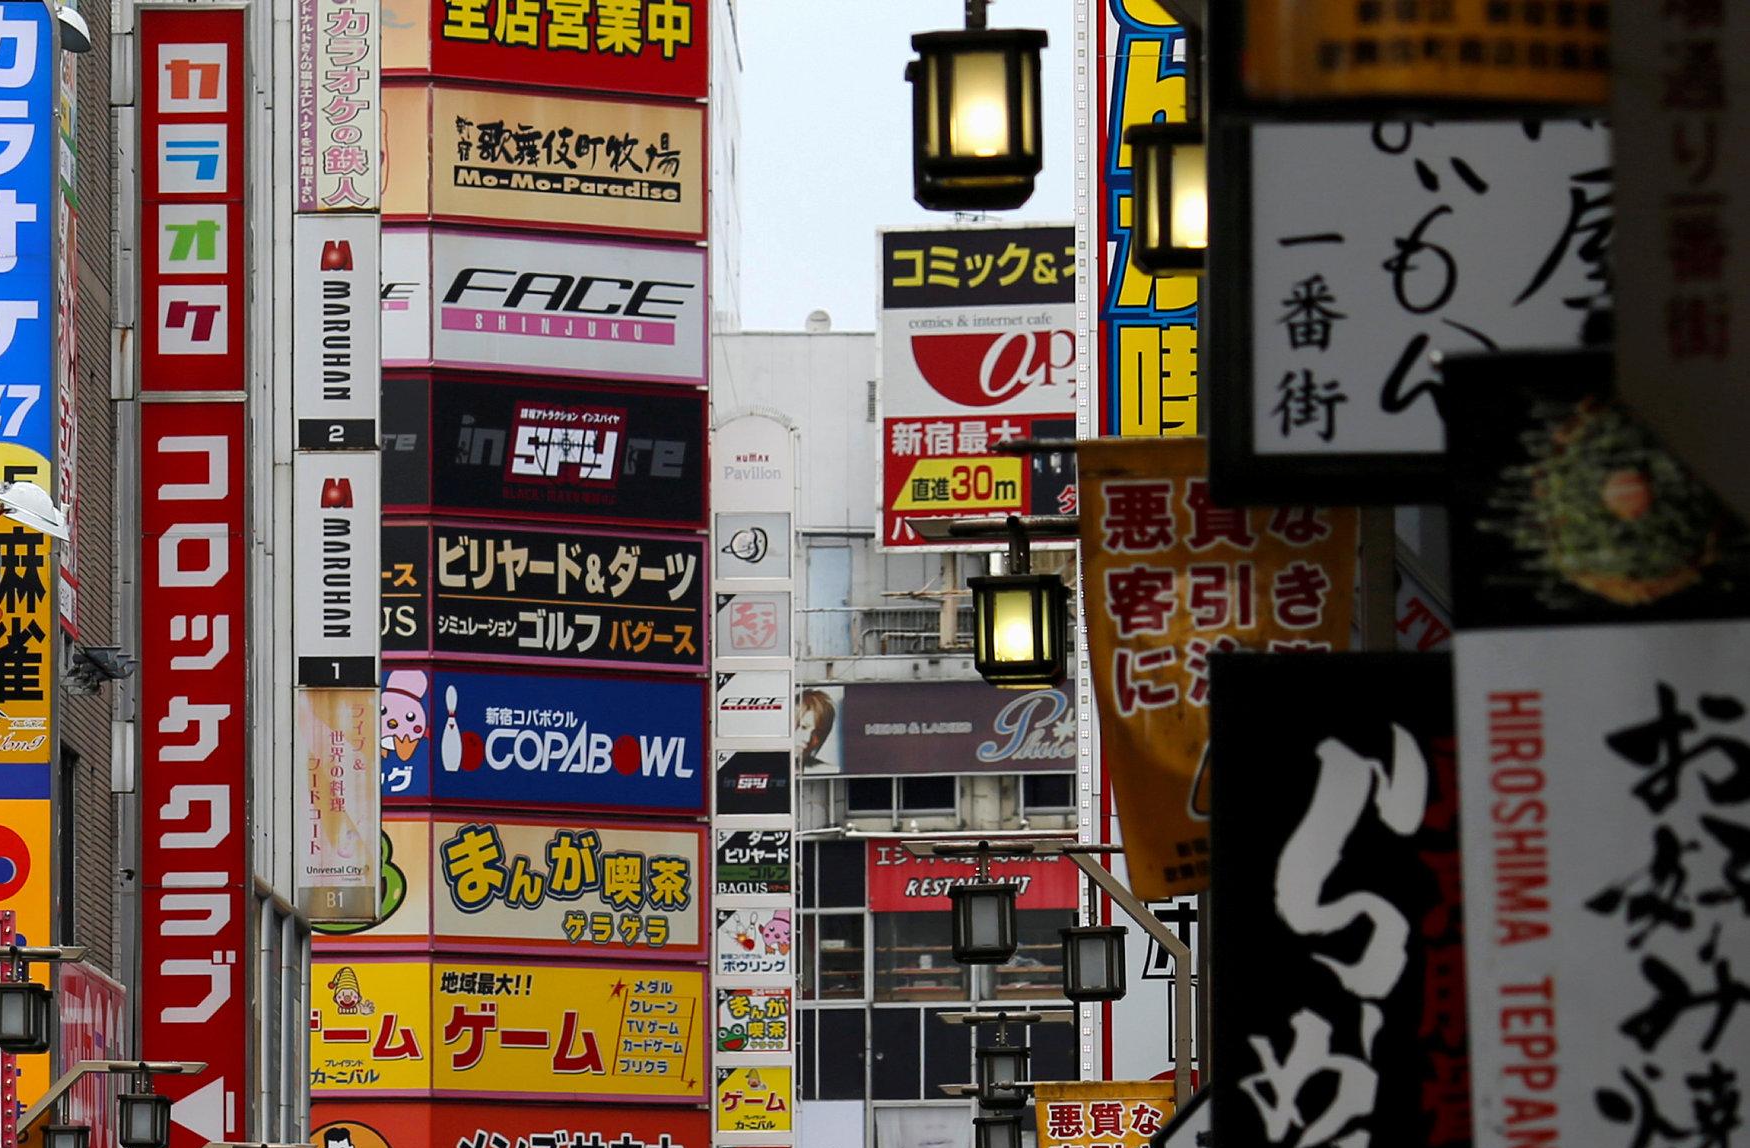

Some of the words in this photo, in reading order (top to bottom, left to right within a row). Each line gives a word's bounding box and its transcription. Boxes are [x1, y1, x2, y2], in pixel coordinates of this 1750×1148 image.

[321, 8, 370, 207] カラオケの鉄人
[456, 169, 680, 201] Mo-Mo-Paradise
[162, 58, 222, 343] カラオケ
[443, 268, 696, 320] FACE
[475, 313, 644, 342] SHINJUKU
[908, 316, 953, 329] comics
[970, 313, 1023, 328] internet
[1025, 312, 1053, 326] cafe
[322, 281, 351, 401] MARUHAN
[1272, 232, 1348, 443] 一番街
[328, 424, 345, 443] 2
[724, 463, 782, 482] Pavilion
[322, 517, 351, 639] MARUHAN
[438, 535, 698, 601] ビリヤード&ダーツ
[438, 618, 518, 641] シミュレーション
[518, 609, 602, 651] ゴルフ
[609, 621, 697, 657] バグース
[330, 662, 340, 680] 1
[156, 434, 237, 1025] コロッケクラブ
[484, 706, 579, 729] 新宿コパボウル
[329, 730, 346, 814] 世界の料理
[1486, 689, 1552, 948] HIROSHIMA
[748, 832, 790, 846] ダーツ
[306, 866, 345, 875] Universal
[724, 848, 790, 865] ビリヤード
[326, 891, 345, 908] B1
[717, 881, 769, 894] BAGUS
[562, 911, 671, 948] ゲラゲラ
[723, 961, 787, 973] ボウリング
[440, 971, 532, 999] 地域最大!!
[633, 979, 674, 996] メダル
[628, 999, 679, 1016] クレーン
[443, 1003, 607, 1077] ゲーム
[622, 1038, 684, 1056] カードゲーム
[618, 1057, 670, 1076] プリクラ
[721, 1091, 788, 1113] ゲーム
[1048, 1103, 1162, 1140] 悪質な
